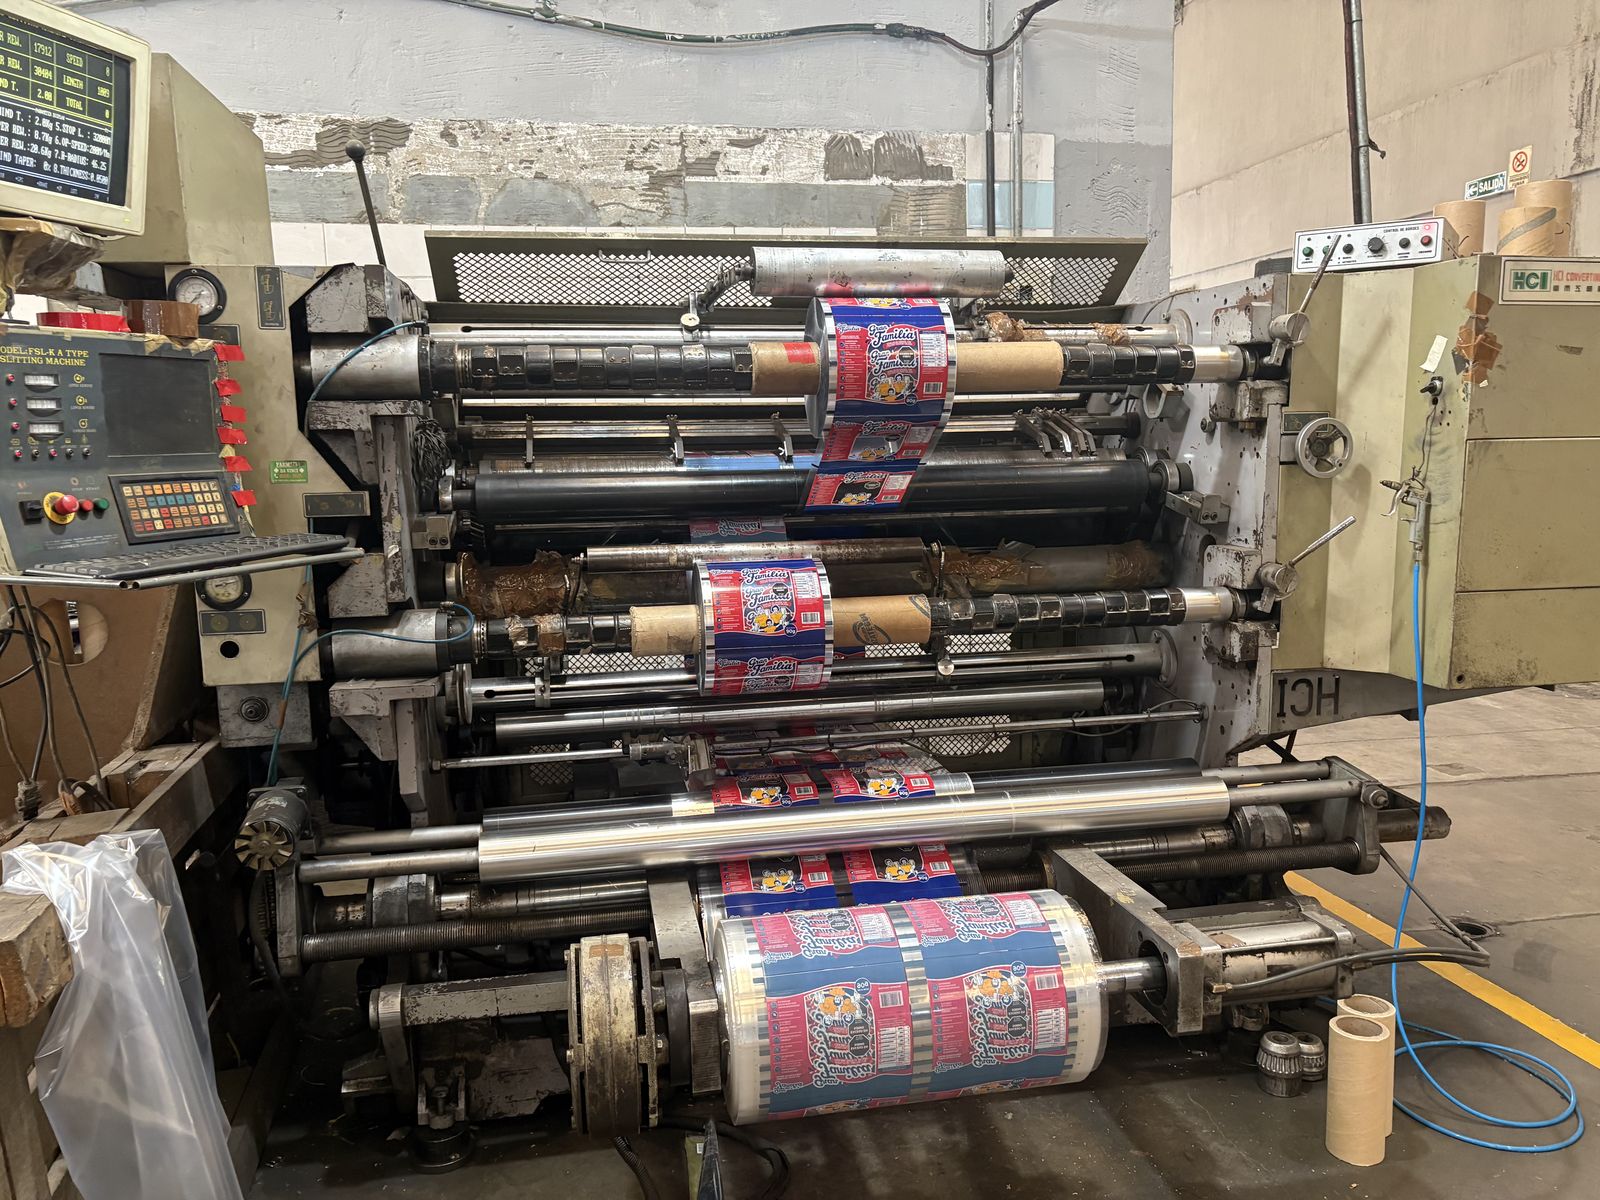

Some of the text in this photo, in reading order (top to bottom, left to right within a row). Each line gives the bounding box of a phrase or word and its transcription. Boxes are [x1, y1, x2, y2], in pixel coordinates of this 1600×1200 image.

[34, 42, 52, 57] 17912
[66, 53, 83, 67] SPEED
[63, 75, 83, 89] LENGTH
[66, 97, 83, 110] TOTAL
[1479, 176, 1504, 192] SALIDA
[1512, 271, 1549, 289] HCI
[872, 328, 916, 348] Familia
[0, 346, 55, 356] ODEL:FSL-K
[0, 355, 86, 366] SLITTING MACHINE
[746, 570, 787, 584] Familia
[751, 660, 794, 677] Familia
